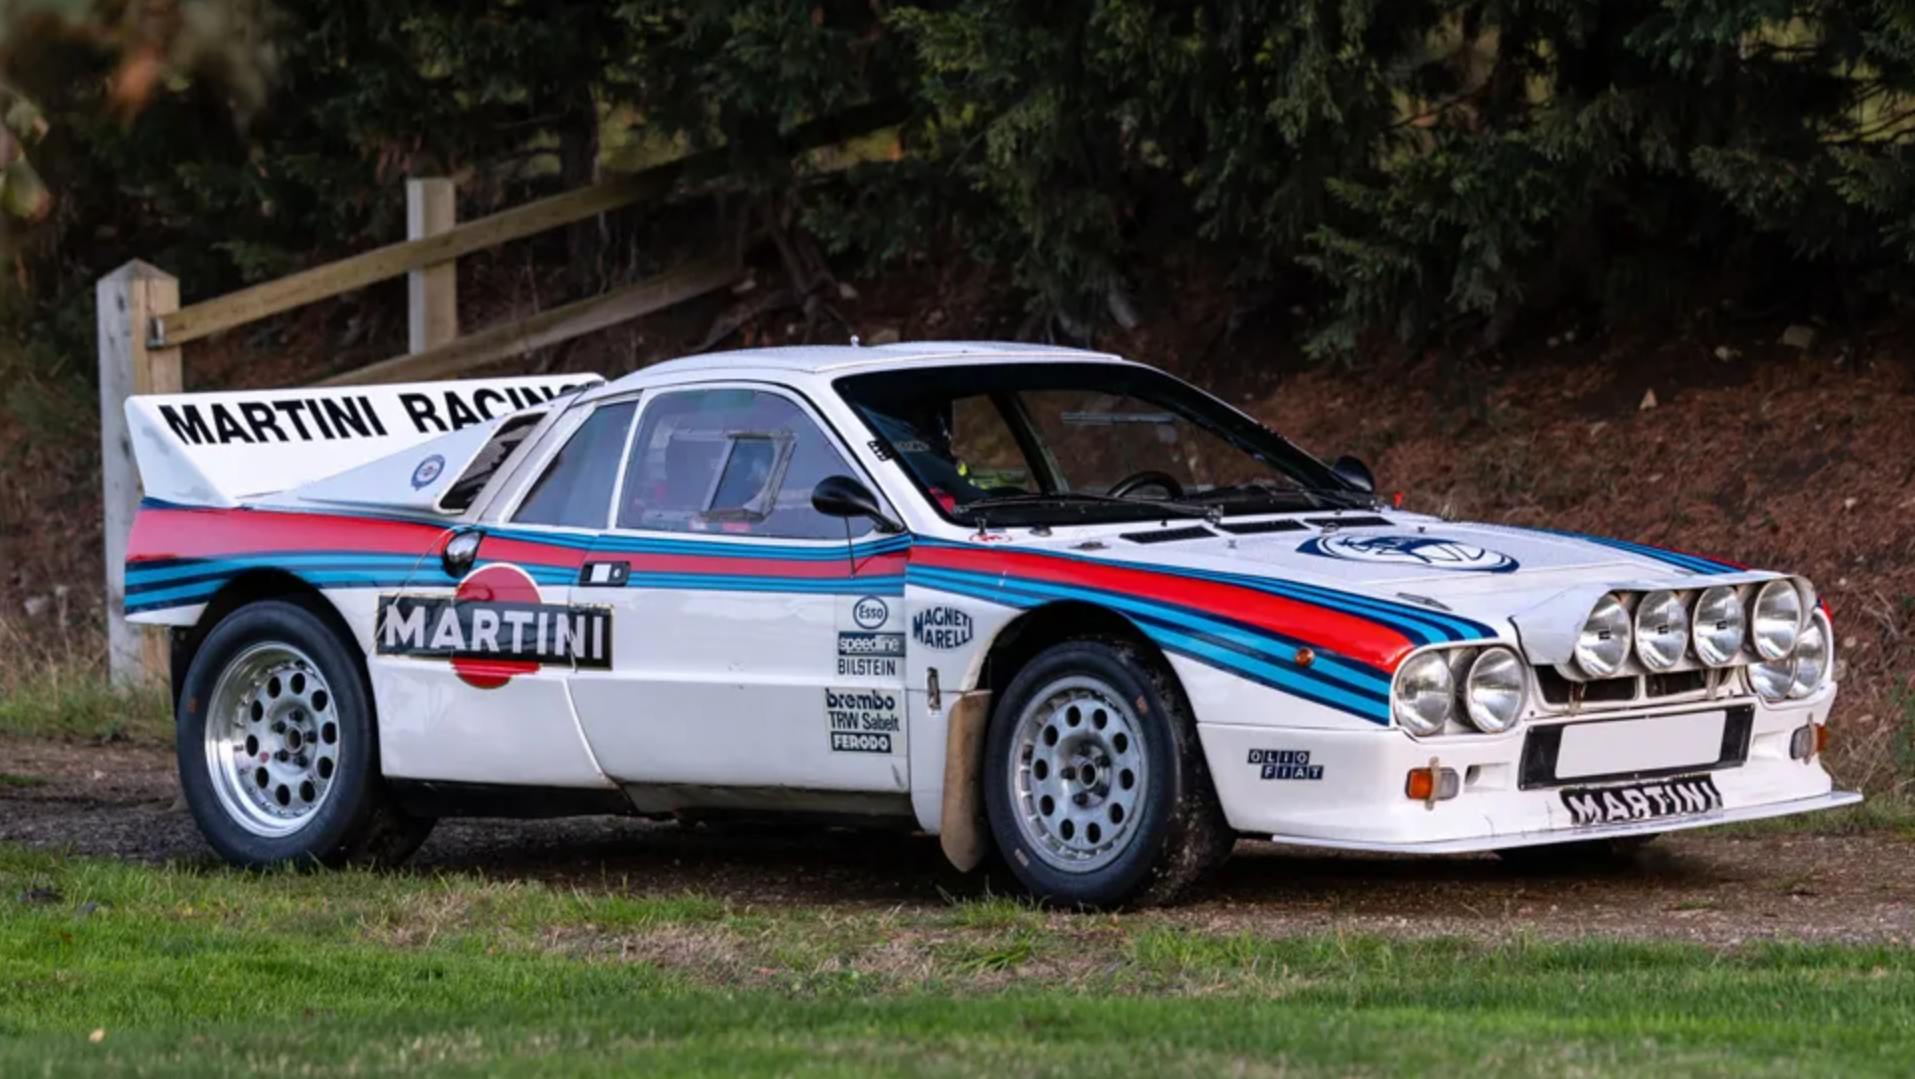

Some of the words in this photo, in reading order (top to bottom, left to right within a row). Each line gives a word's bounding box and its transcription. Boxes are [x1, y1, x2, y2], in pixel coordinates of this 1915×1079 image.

[158, 396, 388, 445] MARTINI
[398, 384, 580, 433] RACI
[858, 605, 884, 619] Esso
[912, 606, 973, 637] MAGNETI
[384, 605, 603, 659] MARTINI
[912, 616, 973, 649] MARELLI
[838, 659, 896, 676] BILSTEIN
[825, 687, 895, 711] brembo
[828, 711, 859, 729] TRW
[862, 711, 900, 732] Sabelt
[833, 734, 888, 751] FERODO
[1249, 750, 1308, 763] OLIO
[1263, 766, 1320, 778] FIAT
[1568, 781, 1718, 825] MARTINI
